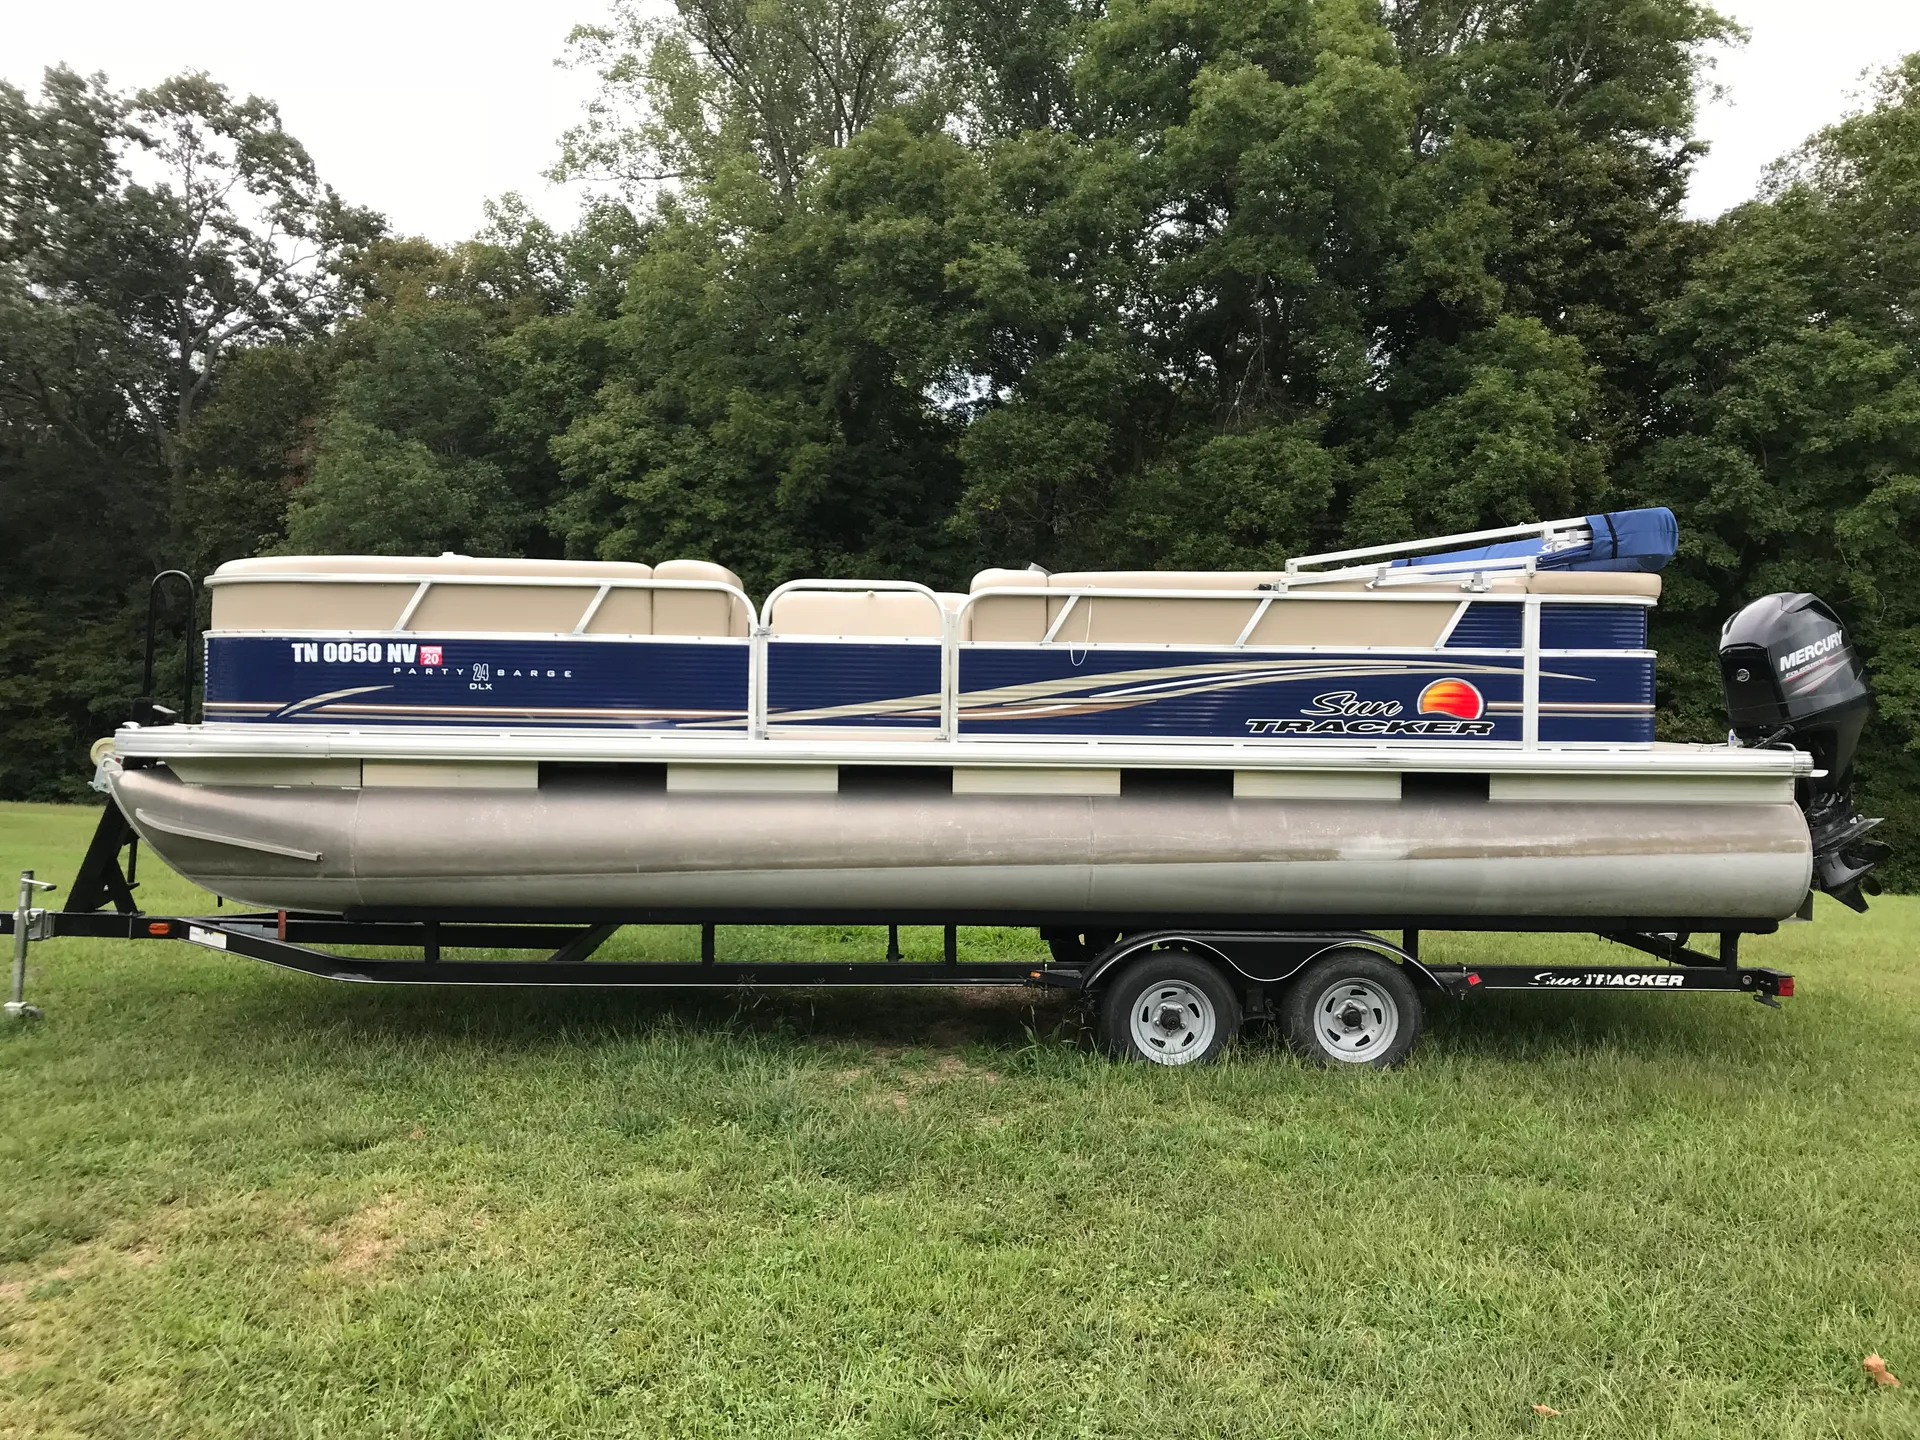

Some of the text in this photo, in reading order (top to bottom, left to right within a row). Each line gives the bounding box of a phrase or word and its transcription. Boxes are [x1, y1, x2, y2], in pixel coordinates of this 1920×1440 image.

[290, 642, 418, 664] TN 0050 NV
[423, 653, 440, 665] 20
[1780, 629, 1842, 671] MERCURY
[393, 662, 572, 682] PARTY 24 BARGE
[469, 682, 493, 691] DLX
[1300, 691, 1403, 717] Sun
[1245, 718, 1495, 736] TRACKER
[1528, 972, 1684, 986] Sun TRACKER
